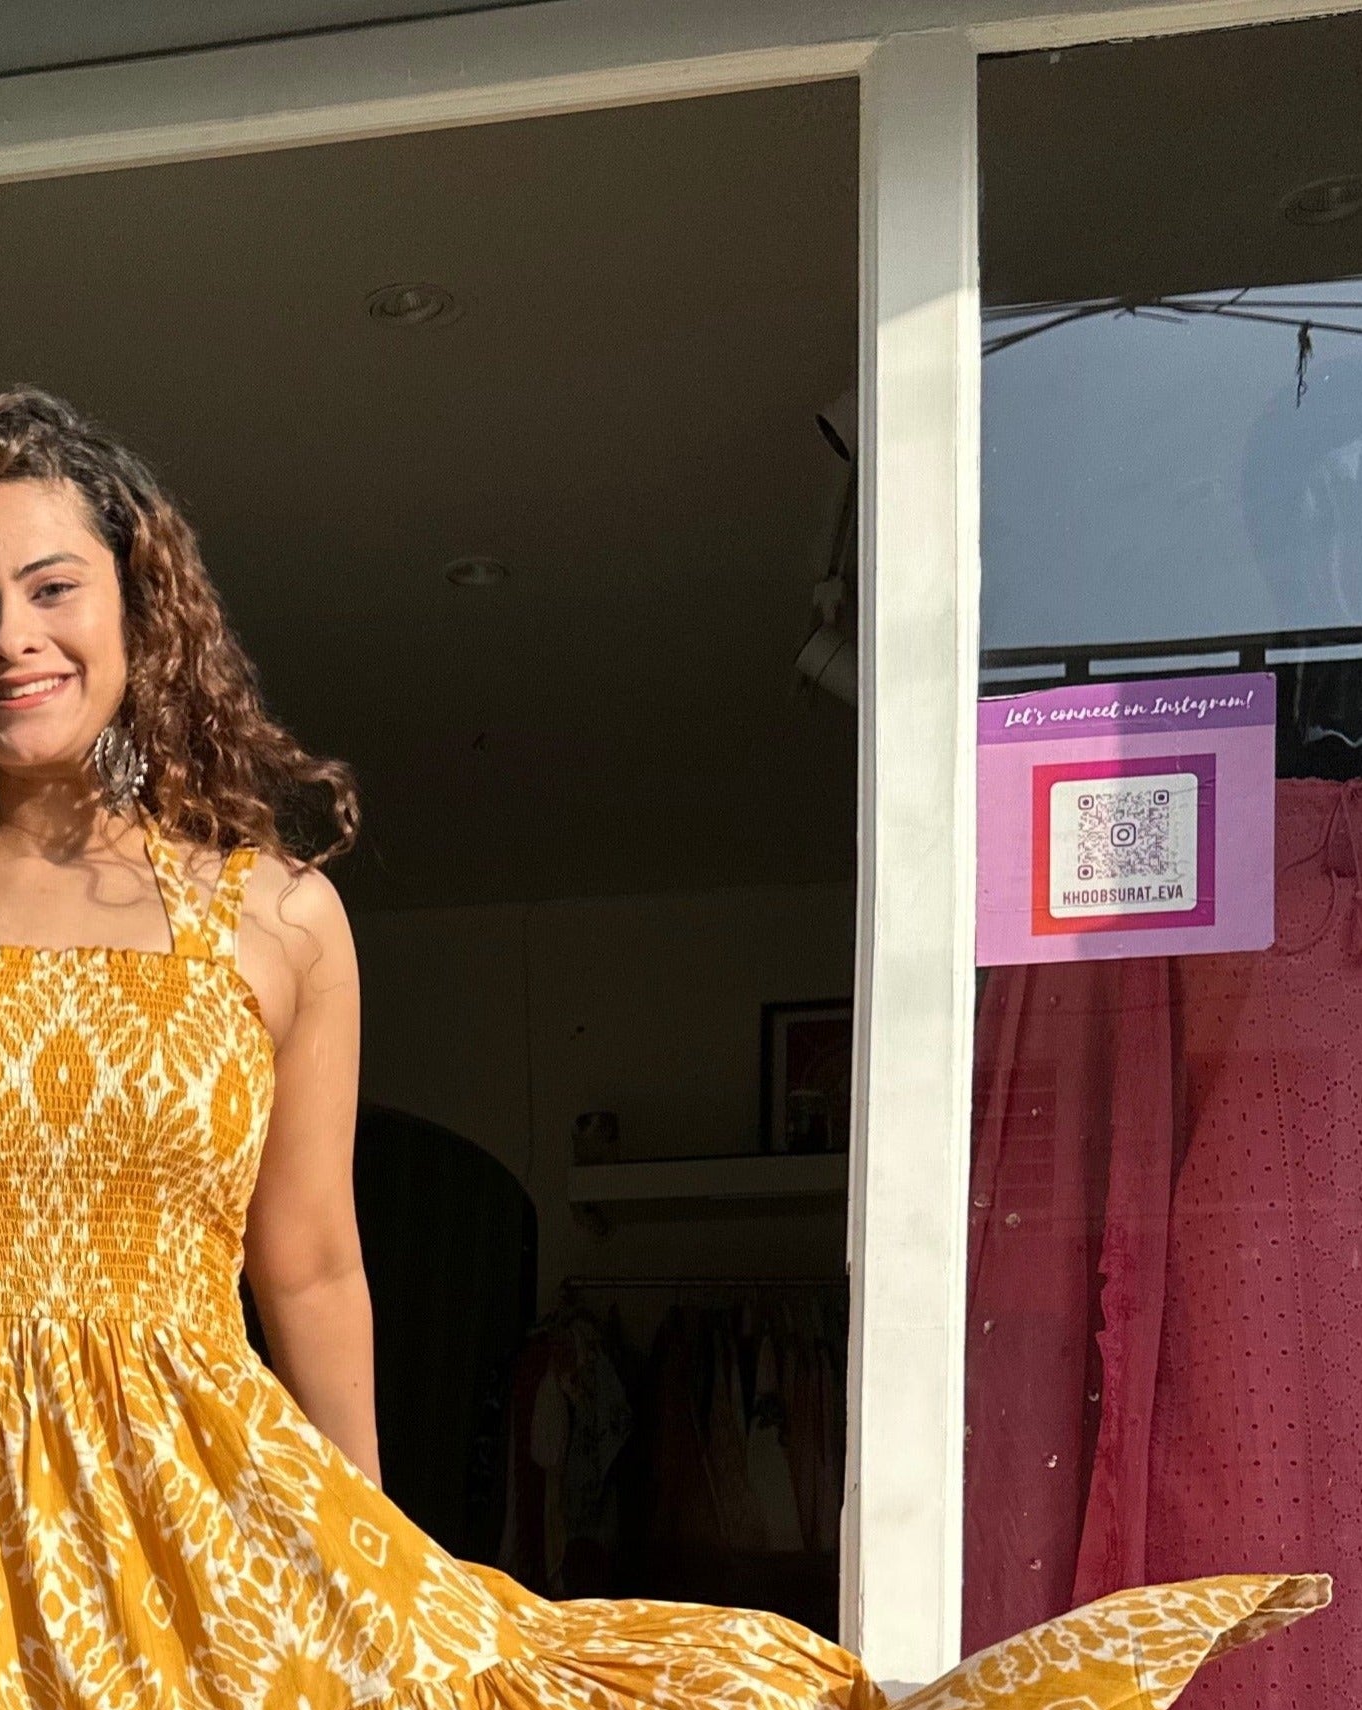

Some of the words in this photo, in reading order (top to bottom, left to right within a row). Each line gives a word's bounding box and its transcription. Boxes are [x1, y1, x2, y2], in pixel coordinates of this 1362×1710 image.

[1004, 707, 1046, 728] Let's
[1050, 699, 1120, 720] connect
[1124, 703, 1148, 717] on
[1150, 690, 1254, 719] Instagram!
